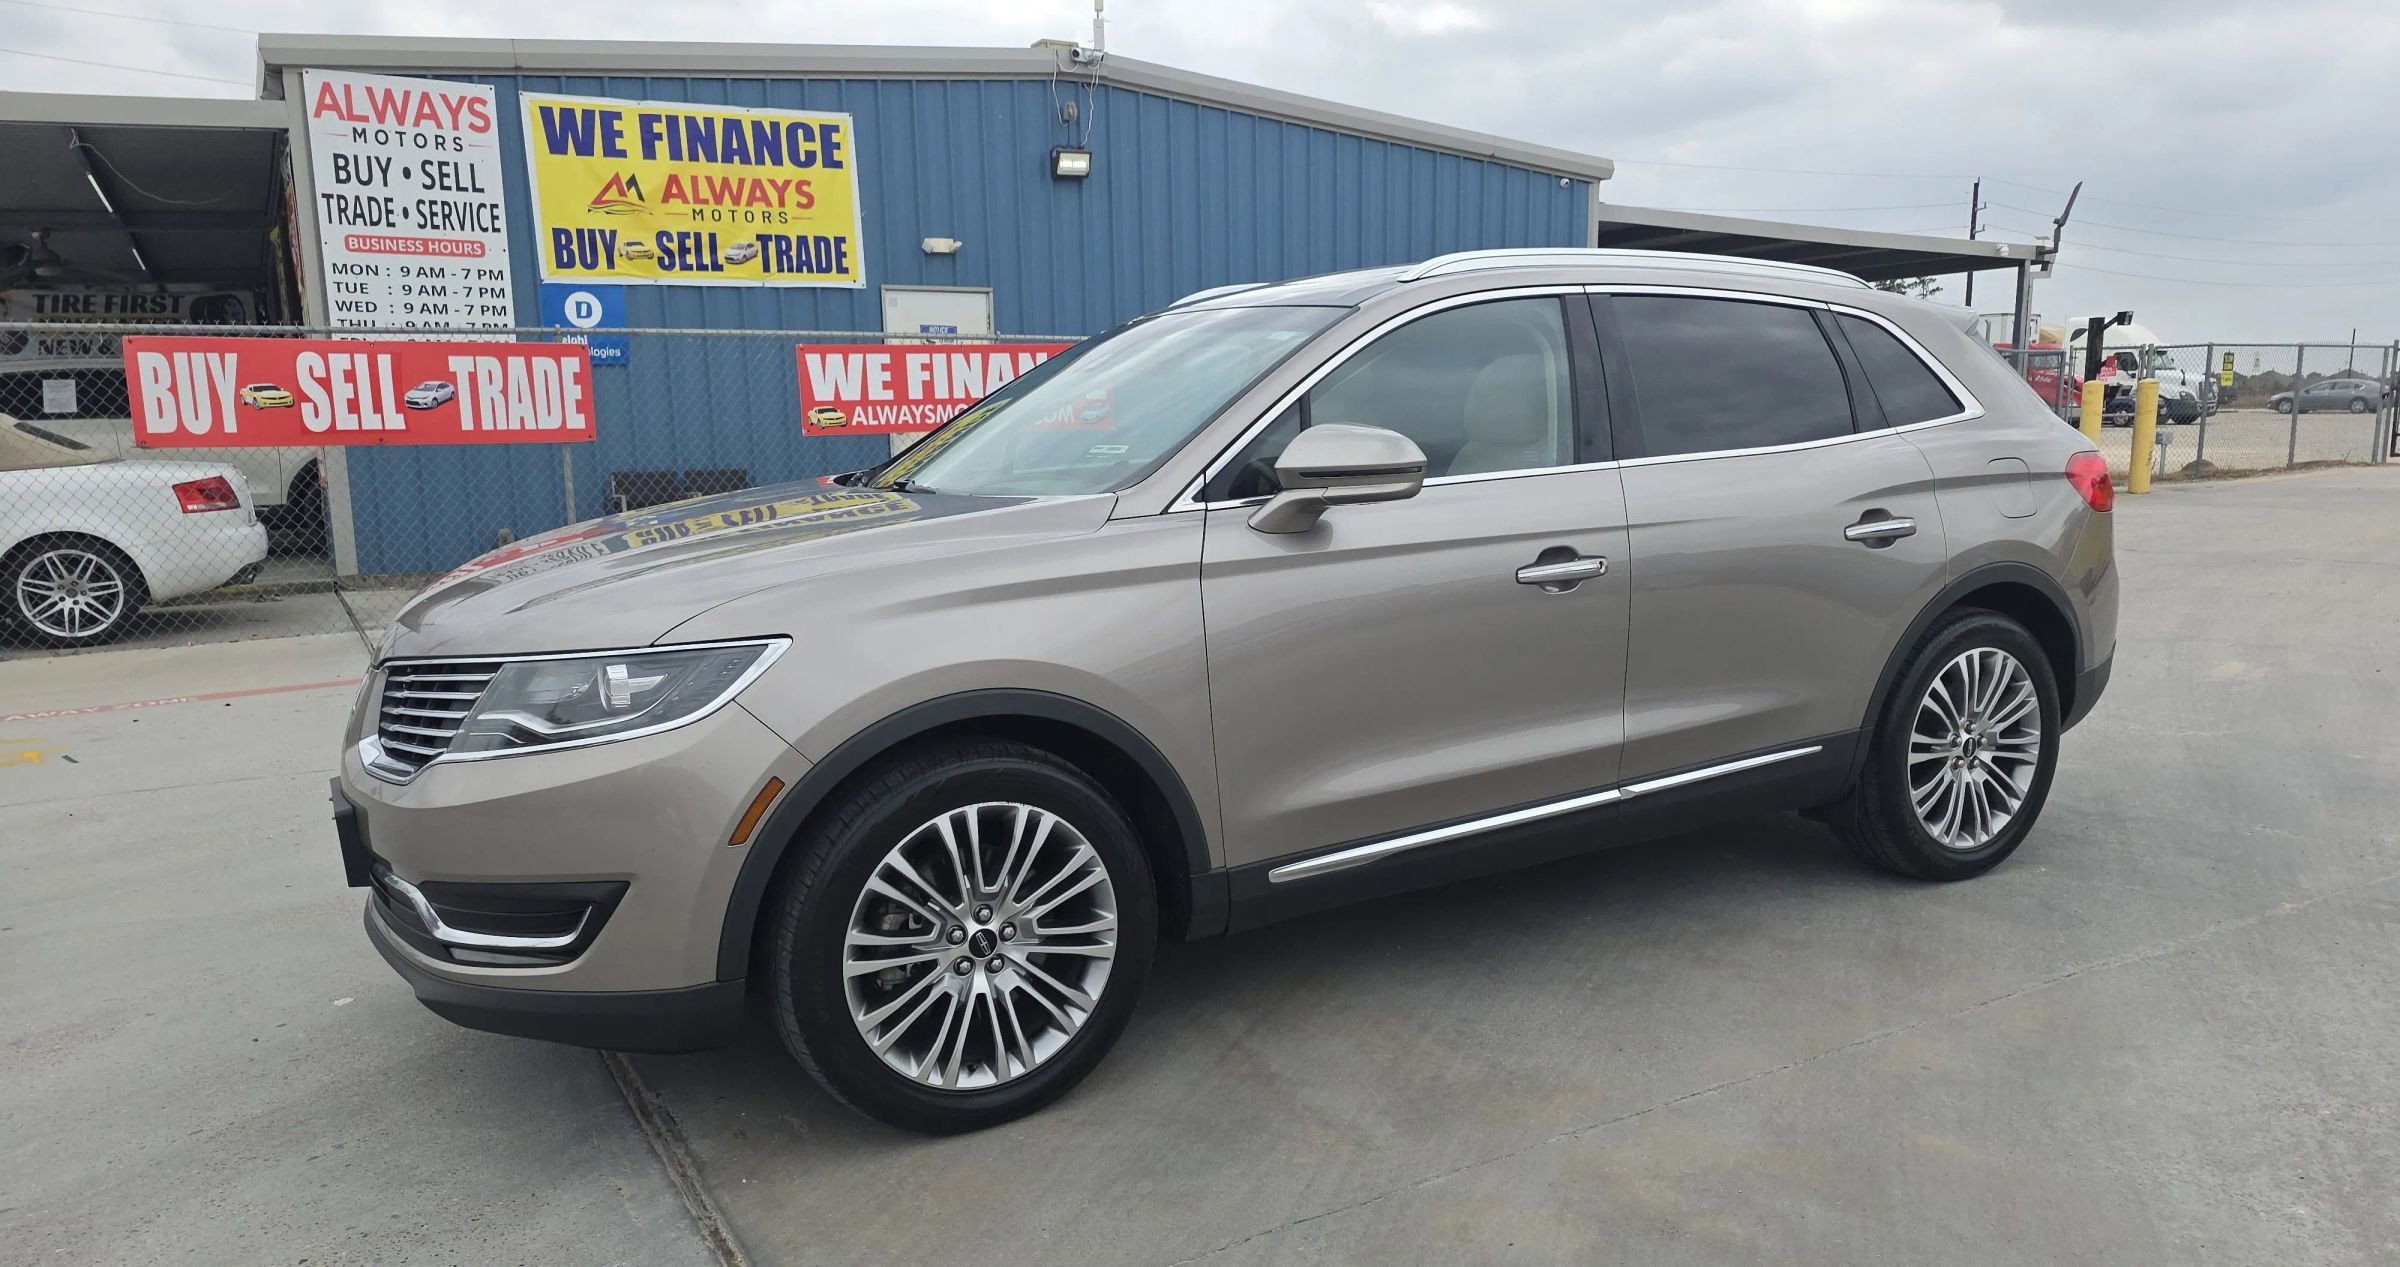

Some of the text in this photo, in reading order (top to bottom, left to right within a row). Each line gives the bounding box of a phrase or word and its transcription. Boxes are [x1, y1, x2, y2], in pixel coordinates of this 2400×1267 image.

[314, 81, 491, 133] ALWAYS
[352, 127, 464, 152] MOTORS
[539, 105, 844, 169] WE FINANCE
[333, 153, 392, 188] BUY
[420, 160, 485, 193] SELL
[661, 173, 815, 210] ALWAYS
[321, 193, 396, 228] TRADE
[416, 199, 501, 233] SERVICE
[692, 208, 789, 225] MOTORS
[348, 237, 482, 255] BUSINESS HOURS
[552, 227, 849, 275] BUY SELL TRADE
[332, 263, 379, 277] MON
[400, 265, 411, 278] 9
[416, 266, 445, 279] AM
[461, 268, 471, 280] 7
[477, 269, 504, 281] PM
[32, 294, 97, 314] TIRE
[333, 281, 369, 294] TUE
[402, 284, 412, 296] 9
[417, 285, 447, 297] AM
[463, 286, 473, 298] 7
[479, 287, 506, 299] PM
[334, 300, 378, 313] WED
[403, 303, 414, 315] 9
[420, 303, 449, 315] AM
[464, 305, 475, 316] 7
[481, 305, 507, 317] PM
[38, 339, 93, 356] NEW
[805, 352, 894, 401] WE
[137, 351, 586, 435] BUY SELL TRADE
